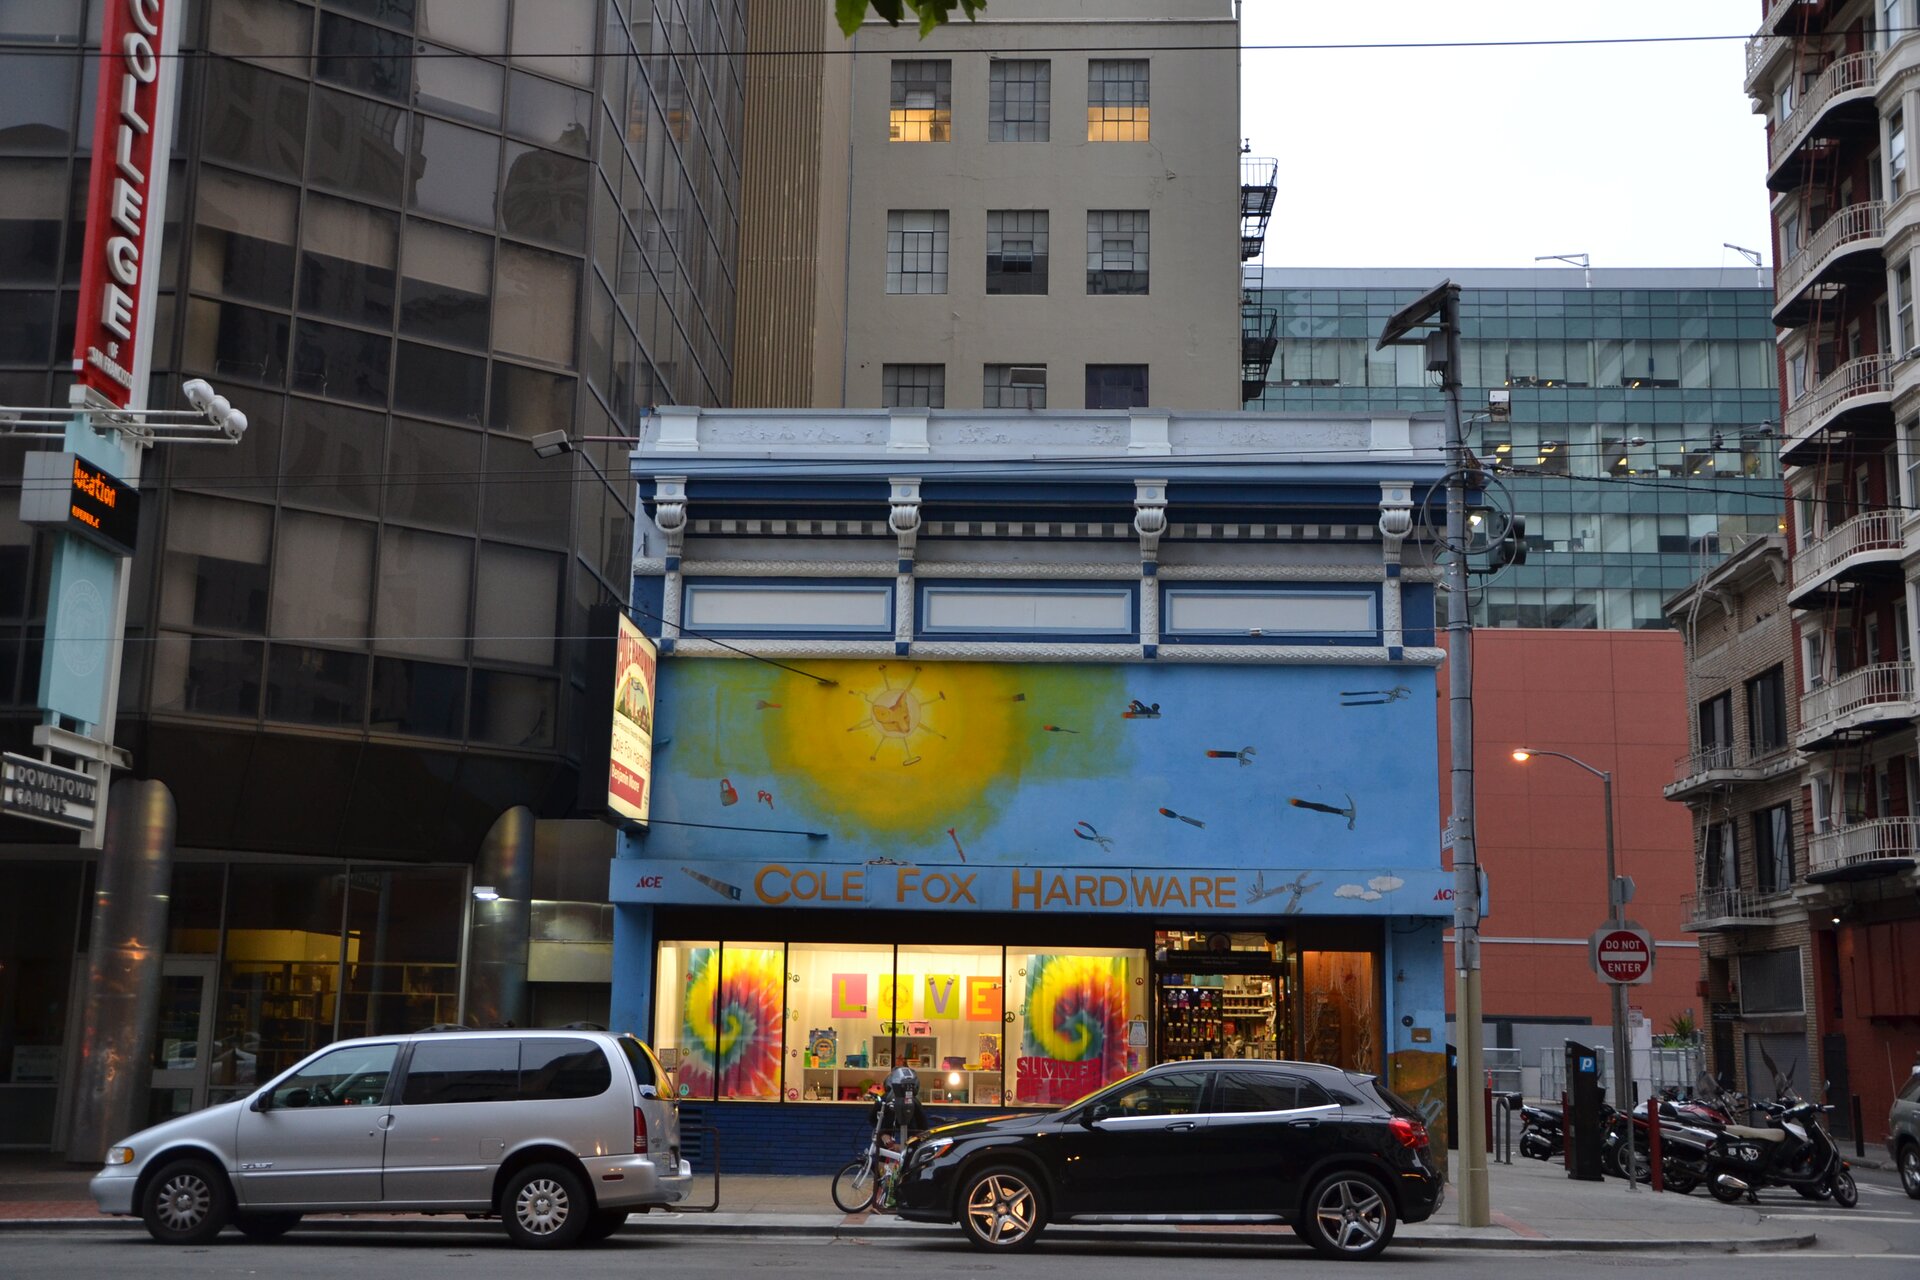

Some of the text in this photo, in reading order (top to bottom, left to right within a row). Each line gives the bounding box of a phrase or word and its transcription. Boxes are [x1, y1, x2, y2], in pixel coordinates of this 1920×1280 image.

[101, 0, 159, 340] COLLEGE
[16, 765, 95, 801] DOWNTOWN
[611, 763, 640, 793] Benjamin Moore
[14, 788, 68, 814] CAMPUS
[636, 876, 663, 889] ACE
[1605, 940, 1641, 950] DO NOT
[1608, 963, 1641, 973] ENTER
